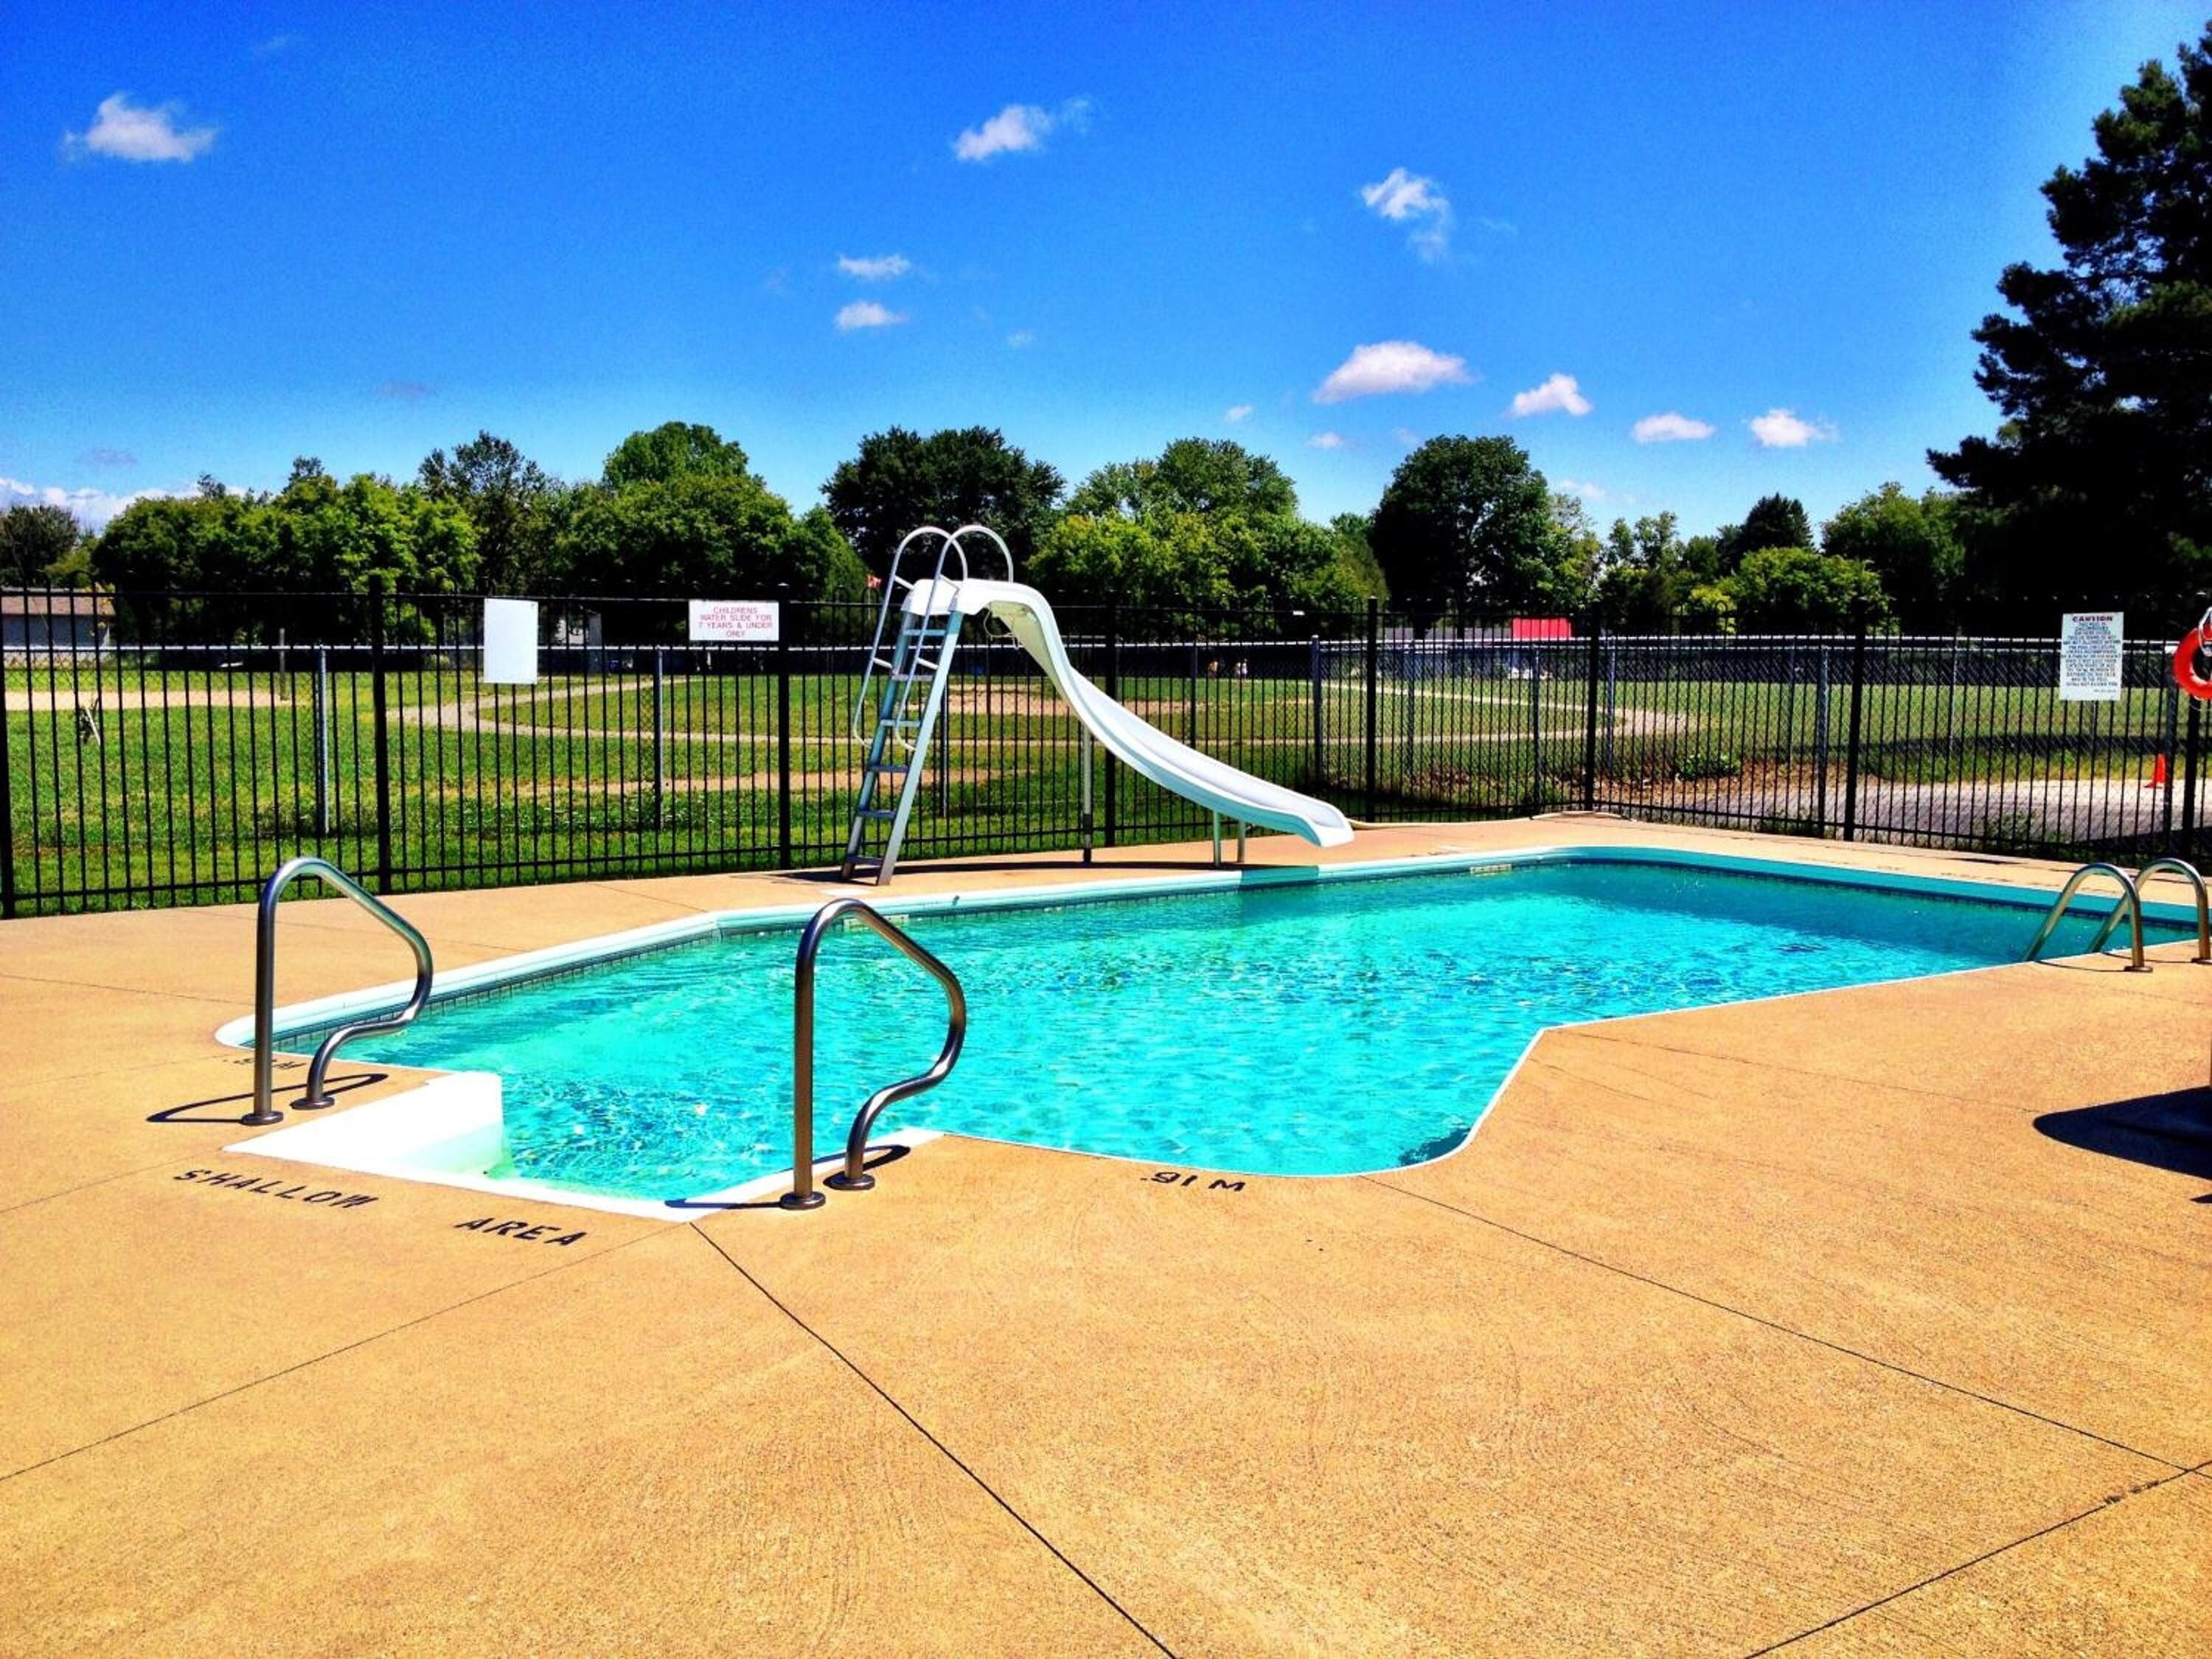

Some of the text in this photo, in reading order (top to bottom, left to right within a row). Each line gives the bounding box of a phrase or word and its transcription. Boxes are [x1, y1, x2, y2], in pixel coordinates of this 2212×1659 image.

[713, 606, 757, 614] CHILDRENS
[726, 630, 745, 638] ONLY
[1208, 1179, 1246, 1192] M
[173, 1170, 587, 1245] SHALLOW AREA
